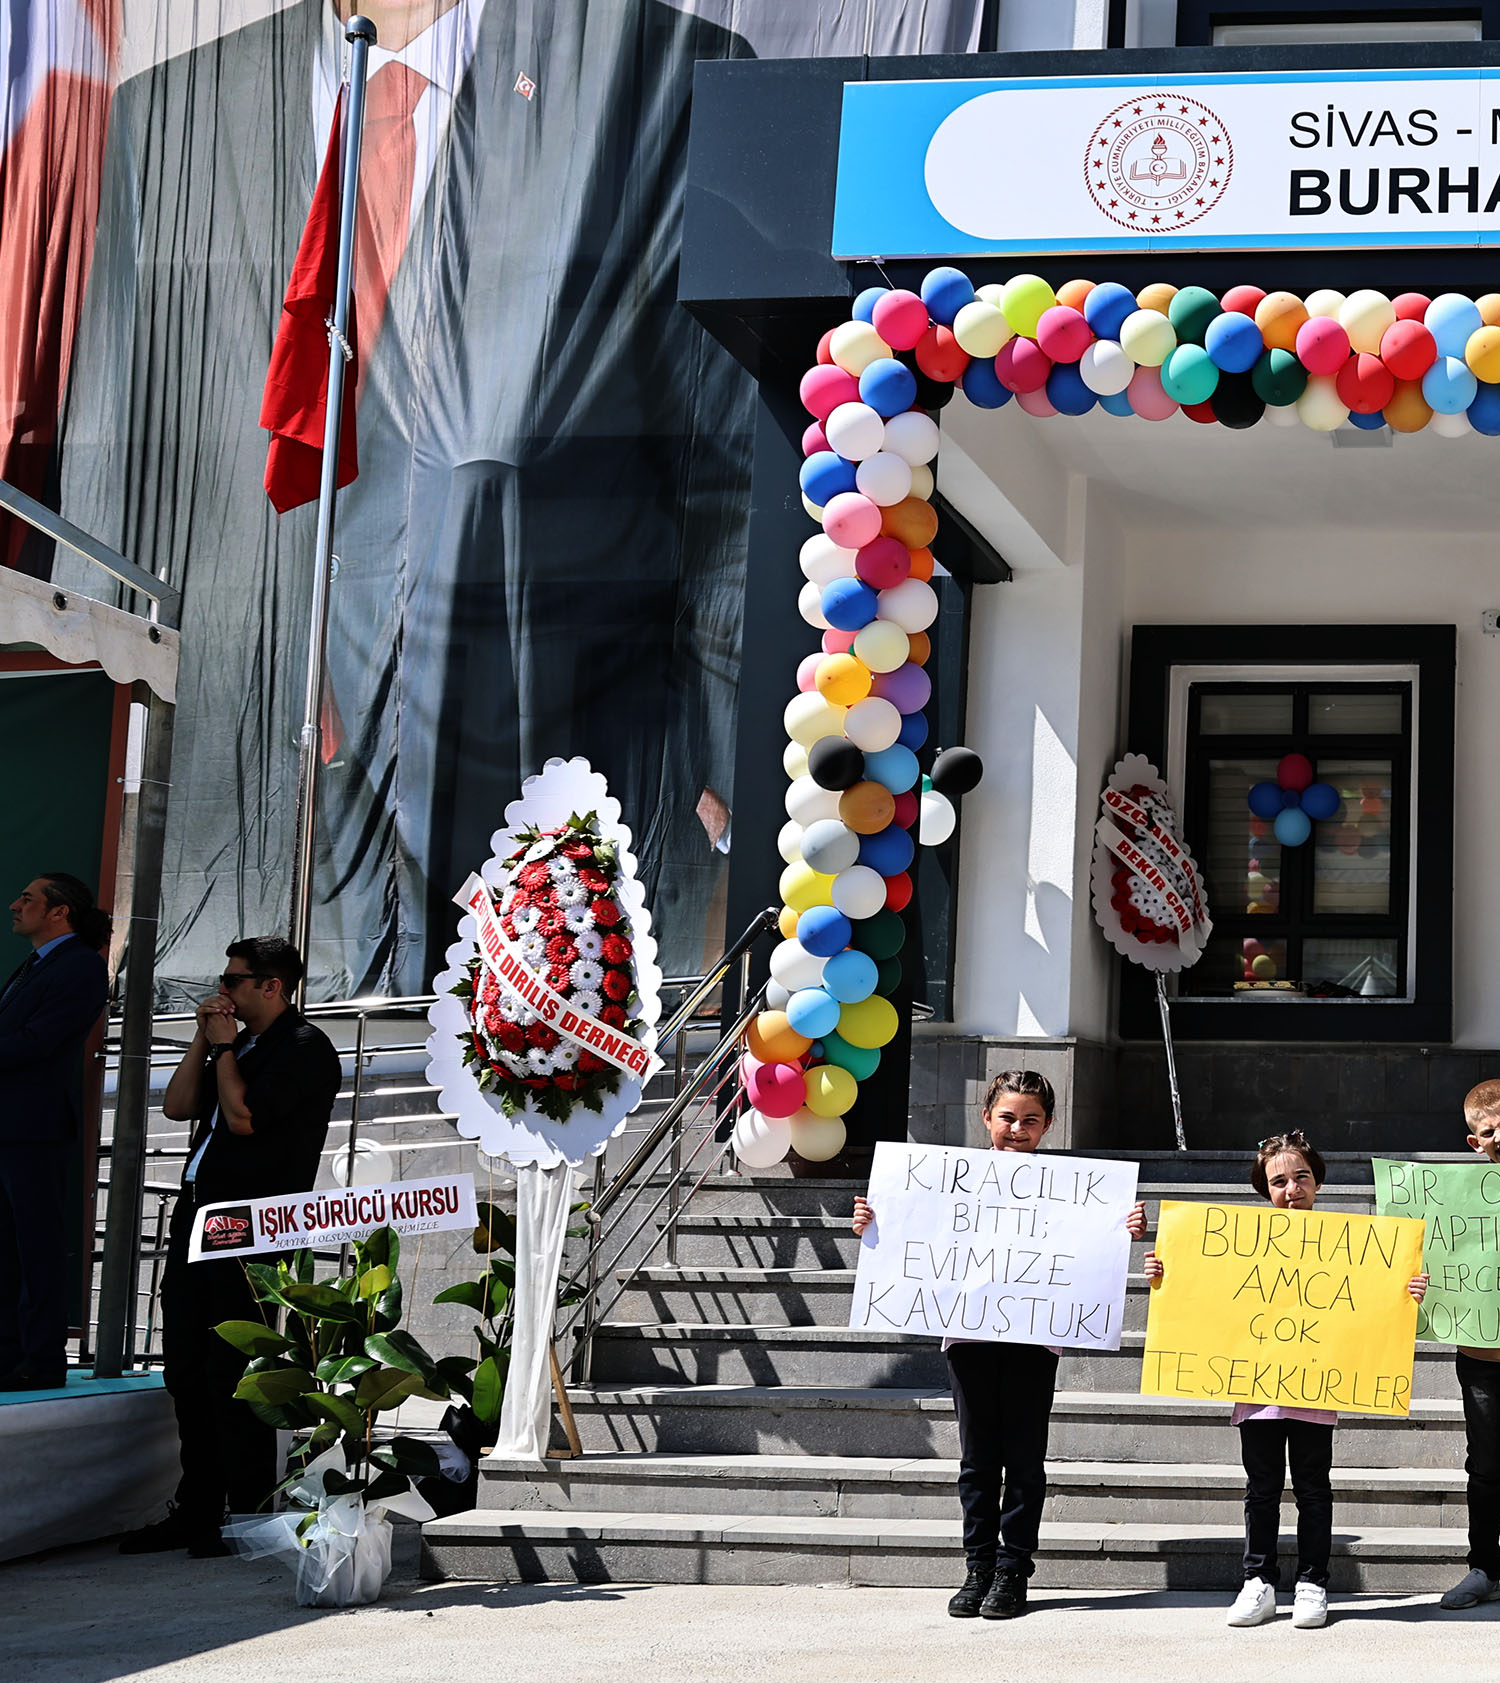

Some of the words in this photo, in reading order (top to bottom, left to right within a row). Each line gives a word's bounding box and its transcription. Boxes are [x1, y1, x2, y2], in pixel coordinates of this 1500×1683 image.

[1112, 119, 1154, 173] CUMHURİYETİ
[1157, 118, 1185, 131] MİLLİ
[1184, 127, 1206, 159] EĞİTİM
[1290, 104, 1438, 148] SİVAS
[1114, 176, 1147, 206] TÜRKİYE
[1168, 162, 1206, 205] BAKANLIĞI
[1116, 839, 1166, 892] BEKİR
[1165, 891, 1192, 933] ÇAM
[499, 953, 560, 1022] DİRİLİŞ
[559, 1008, 653, 1078] DERNEĞİ
[1388, 1163, 1444, 1206] BİR
[259, 1204, 299, 1243] IŞIK
[303, 1188, 386, 1231] SÜRÜCÜ
[391, 1185, 459, 1220] KURSU
[1202, 1207, 1399, 1269] BURHAN
[863, 1281, 1111, 1342] KAVUŞTUK!
[1233, 1264, 1355, 1312] AMCA
[1249, 1313, 1321, 1345] ÇOK
[1146, 1350, 1411, 1411] TEŞEKKÜRLER
